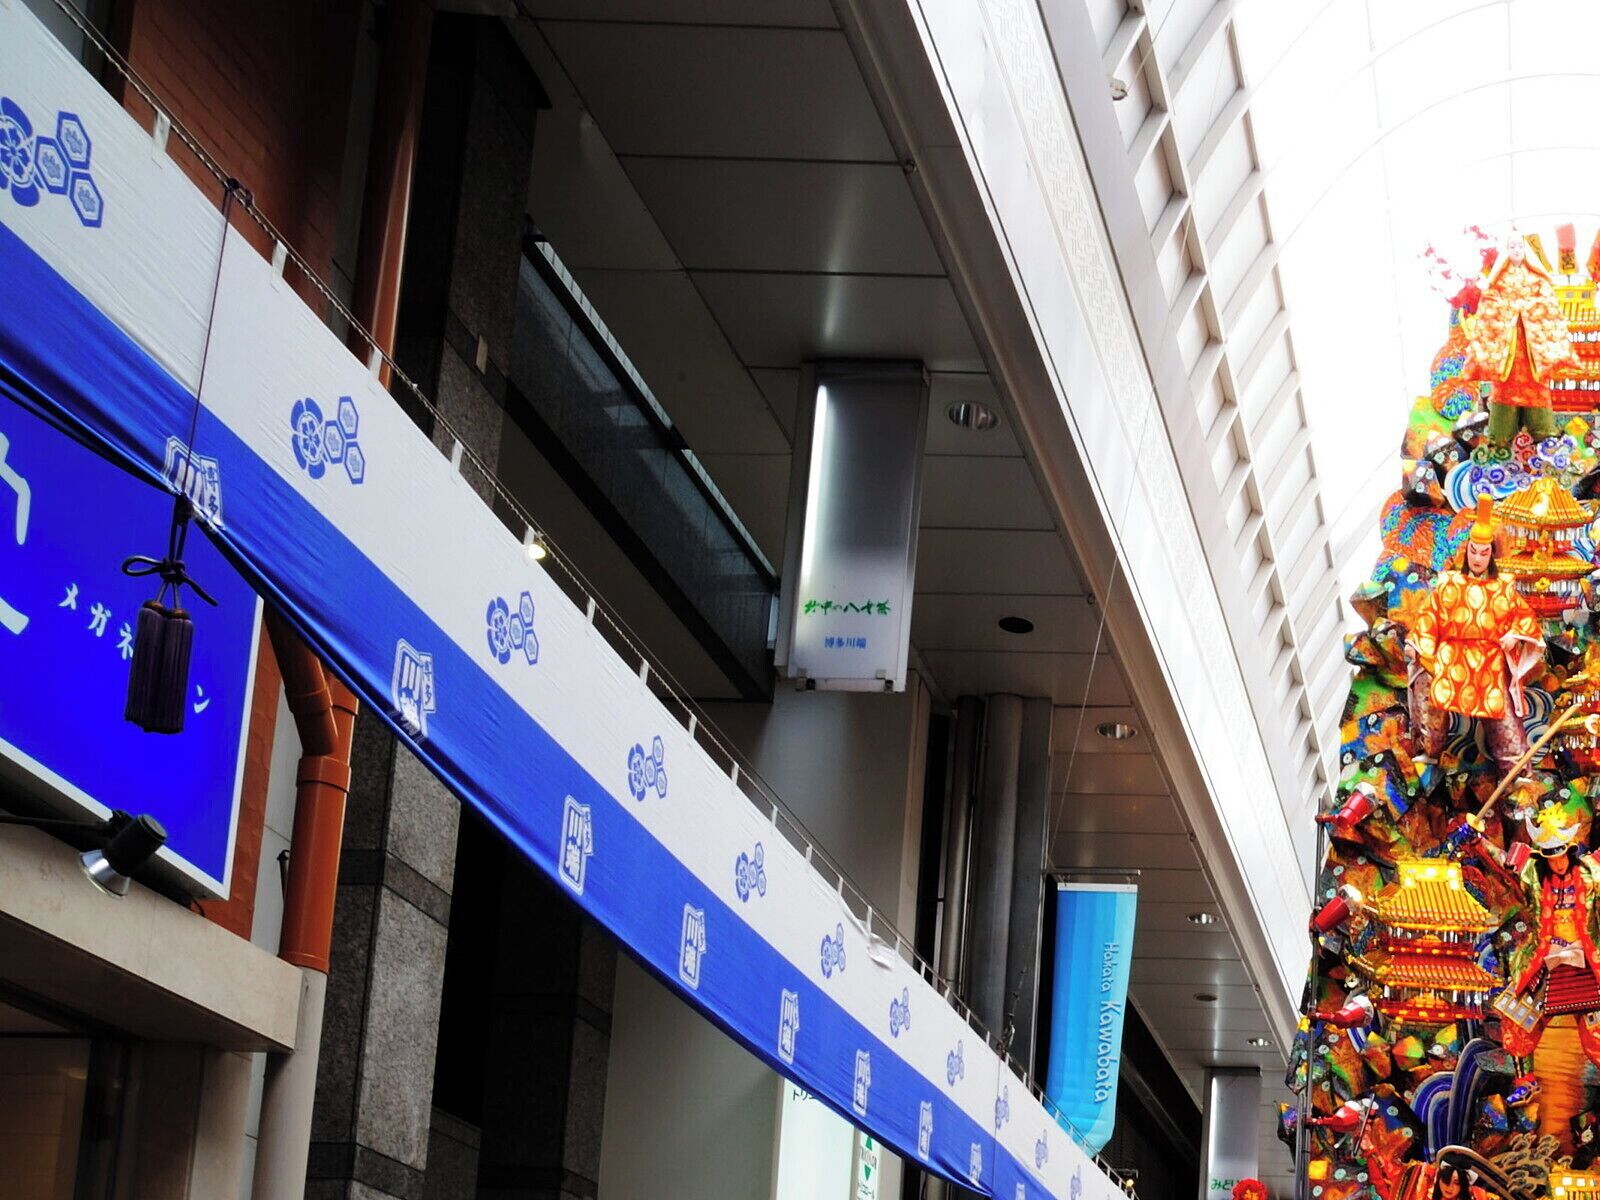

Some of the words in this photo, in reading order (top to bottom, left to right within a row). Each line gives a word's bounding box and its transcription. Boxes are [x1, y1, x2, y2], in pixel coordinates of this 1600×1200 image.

[58, 582, 212, 715] メガネン
[1101, 942, 1119, 992] Hakata
[1094, 1000, 1122, 1104] Kawabata
